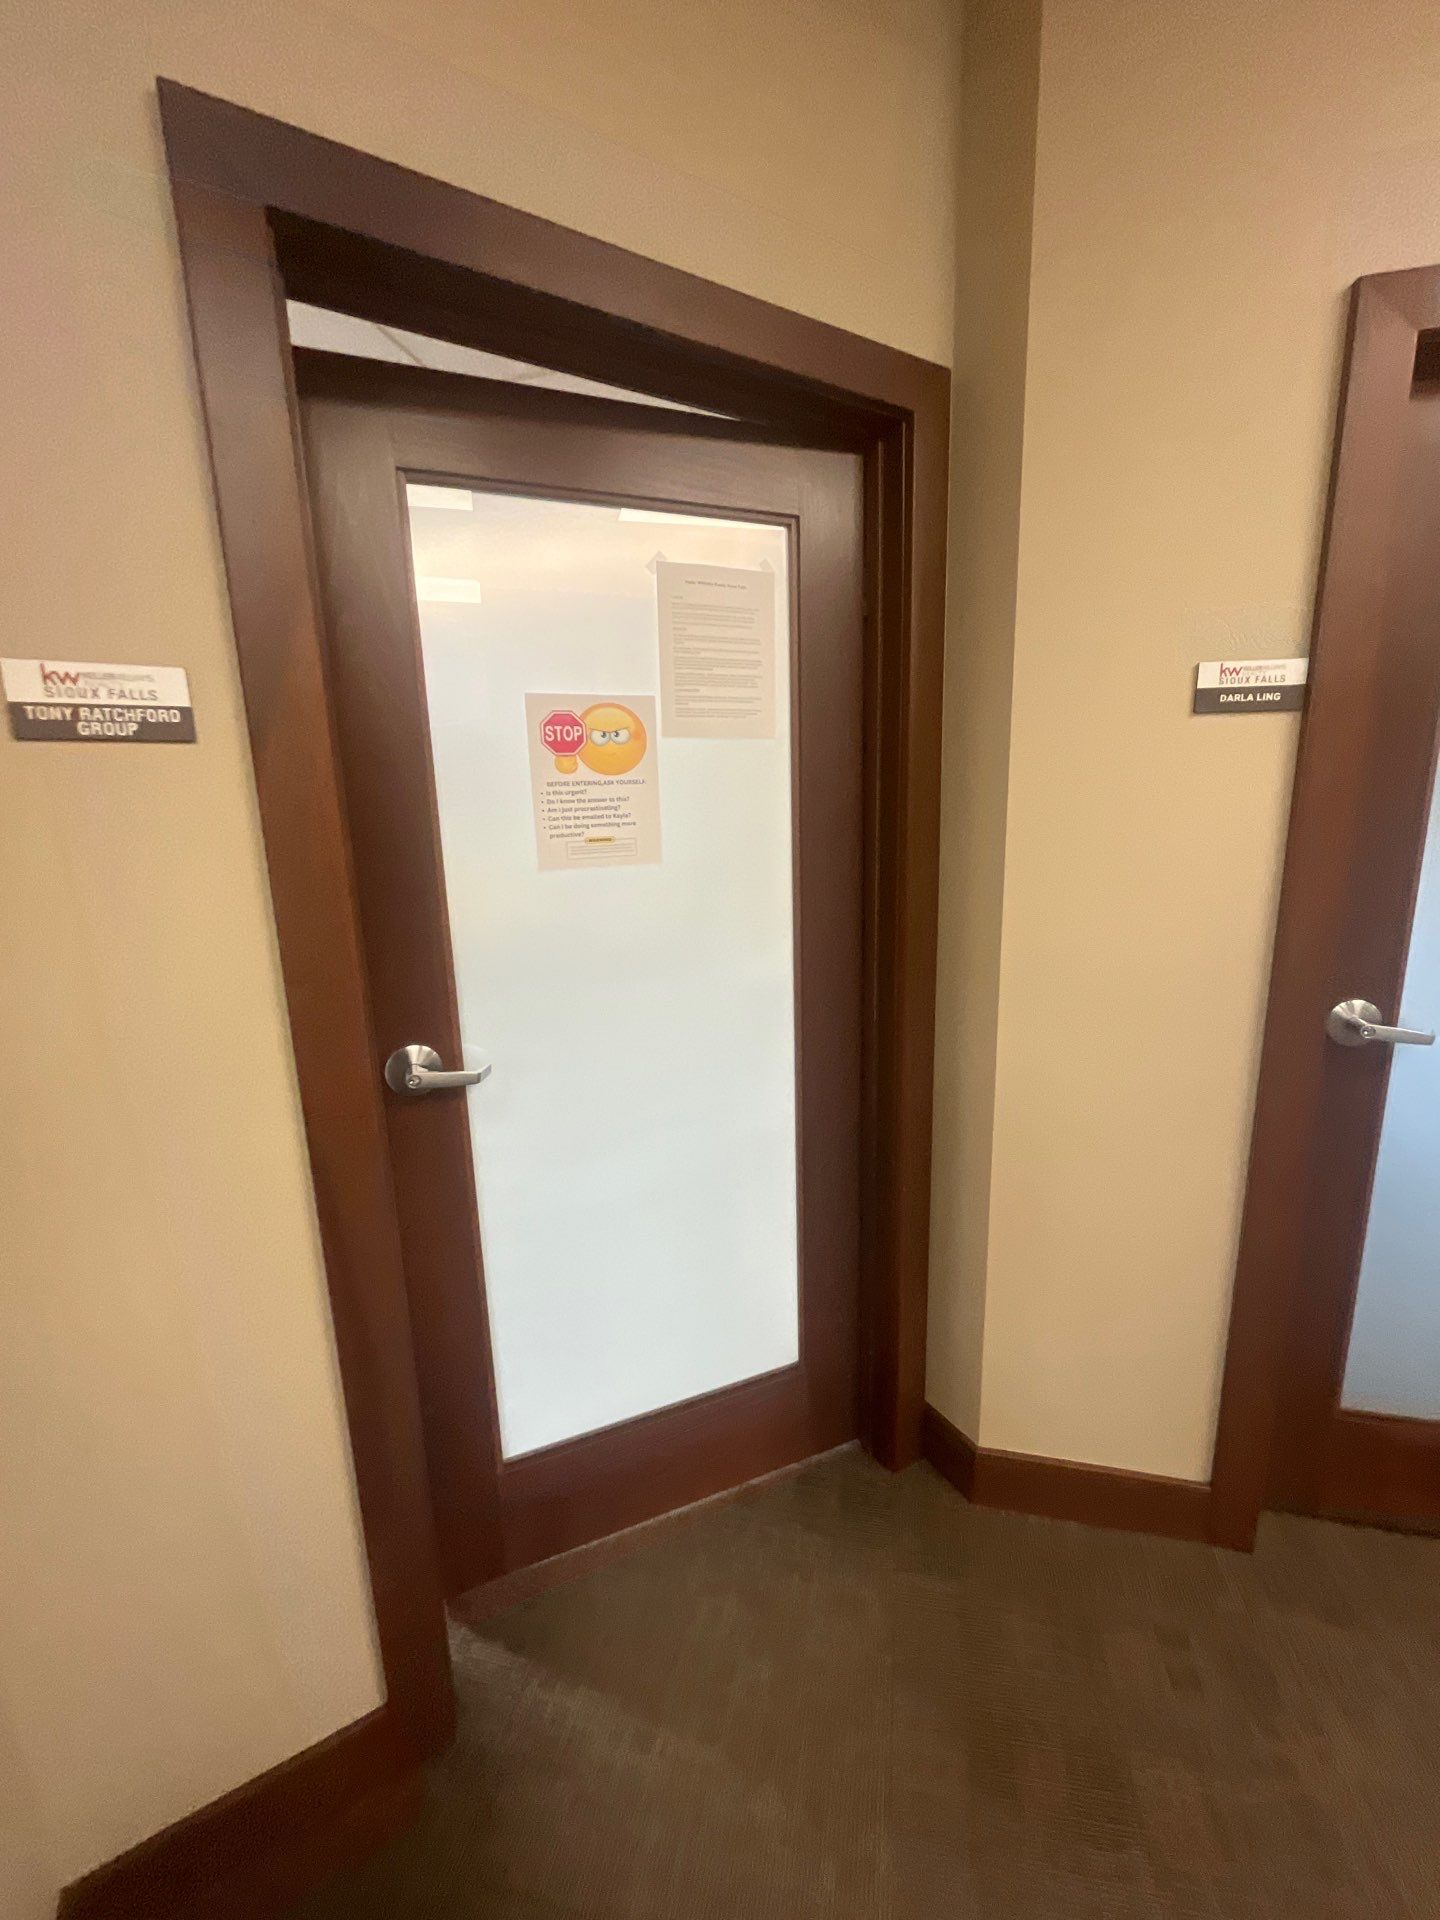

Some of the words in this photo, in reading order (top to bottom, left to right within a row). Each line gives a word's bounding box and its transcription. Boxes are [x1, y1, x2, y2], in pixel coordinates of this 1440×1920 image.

[40, 663, 80, 686] kw
[1220, 663, 1242, 677] kw
[1219, 676, 1251, 685] SIOUX
[1255, 674, 1286, 684] FALLS
[43, 686, 101, 699] SIOUX
[107, 688, 158, 701] FALLS
[1220, 693, 1254, 702] DARLA
[1256, 692, 1281, 701] LING
[22, 705, 74, 721] TONY
[79, 707, 181, 723] RATCHFORD
[77, 722, 139, 736] GROUP
[545, 725, 582, 741] STOP
[574, 804, 620, 812] procrastinating?
[550, 831, 584, 839] productive?
